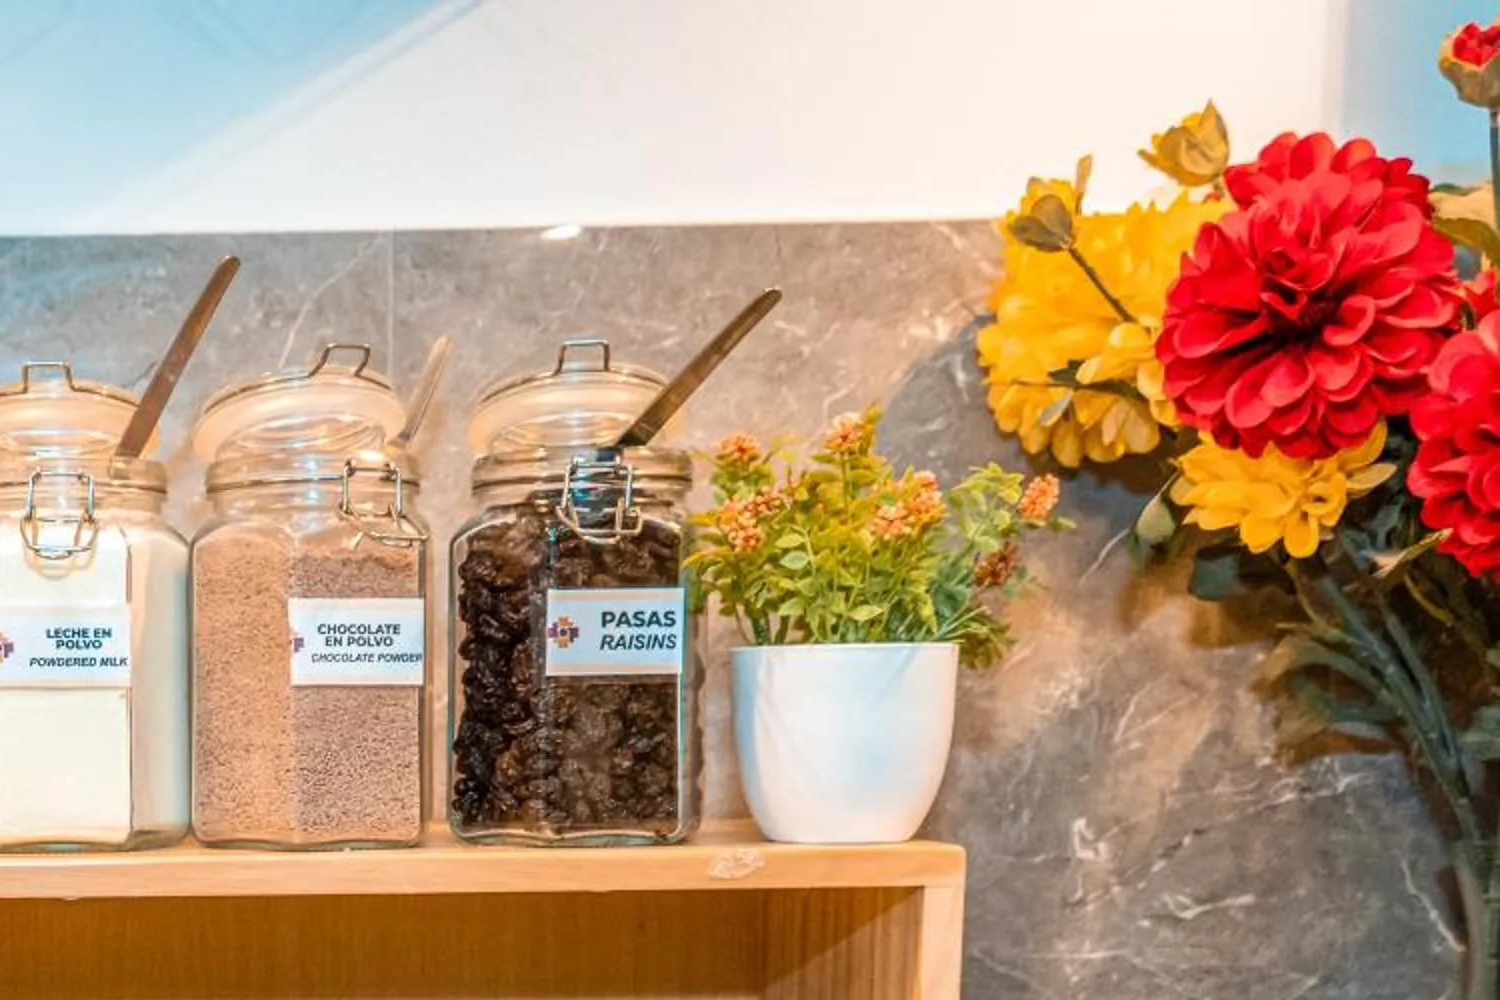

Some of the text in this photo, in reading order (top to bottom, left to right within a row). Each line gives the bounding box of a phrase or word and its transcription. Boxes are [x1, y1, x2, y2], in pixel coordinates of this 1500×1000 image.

[601, 610, 677, 628] PASAS
[45, 627, 113, 639] LECHE EN
[317, 623, 402, 635] CHOCOLATE
[55, 639, 104, 650] POLVO
[325, 636, 394, 647] EN POLVO
[600, 633, 677, 650] RAISINS
[29, 657, 129, 667] POWDERED MILK
[311, 653, 375, 663] CHOCOLATE
